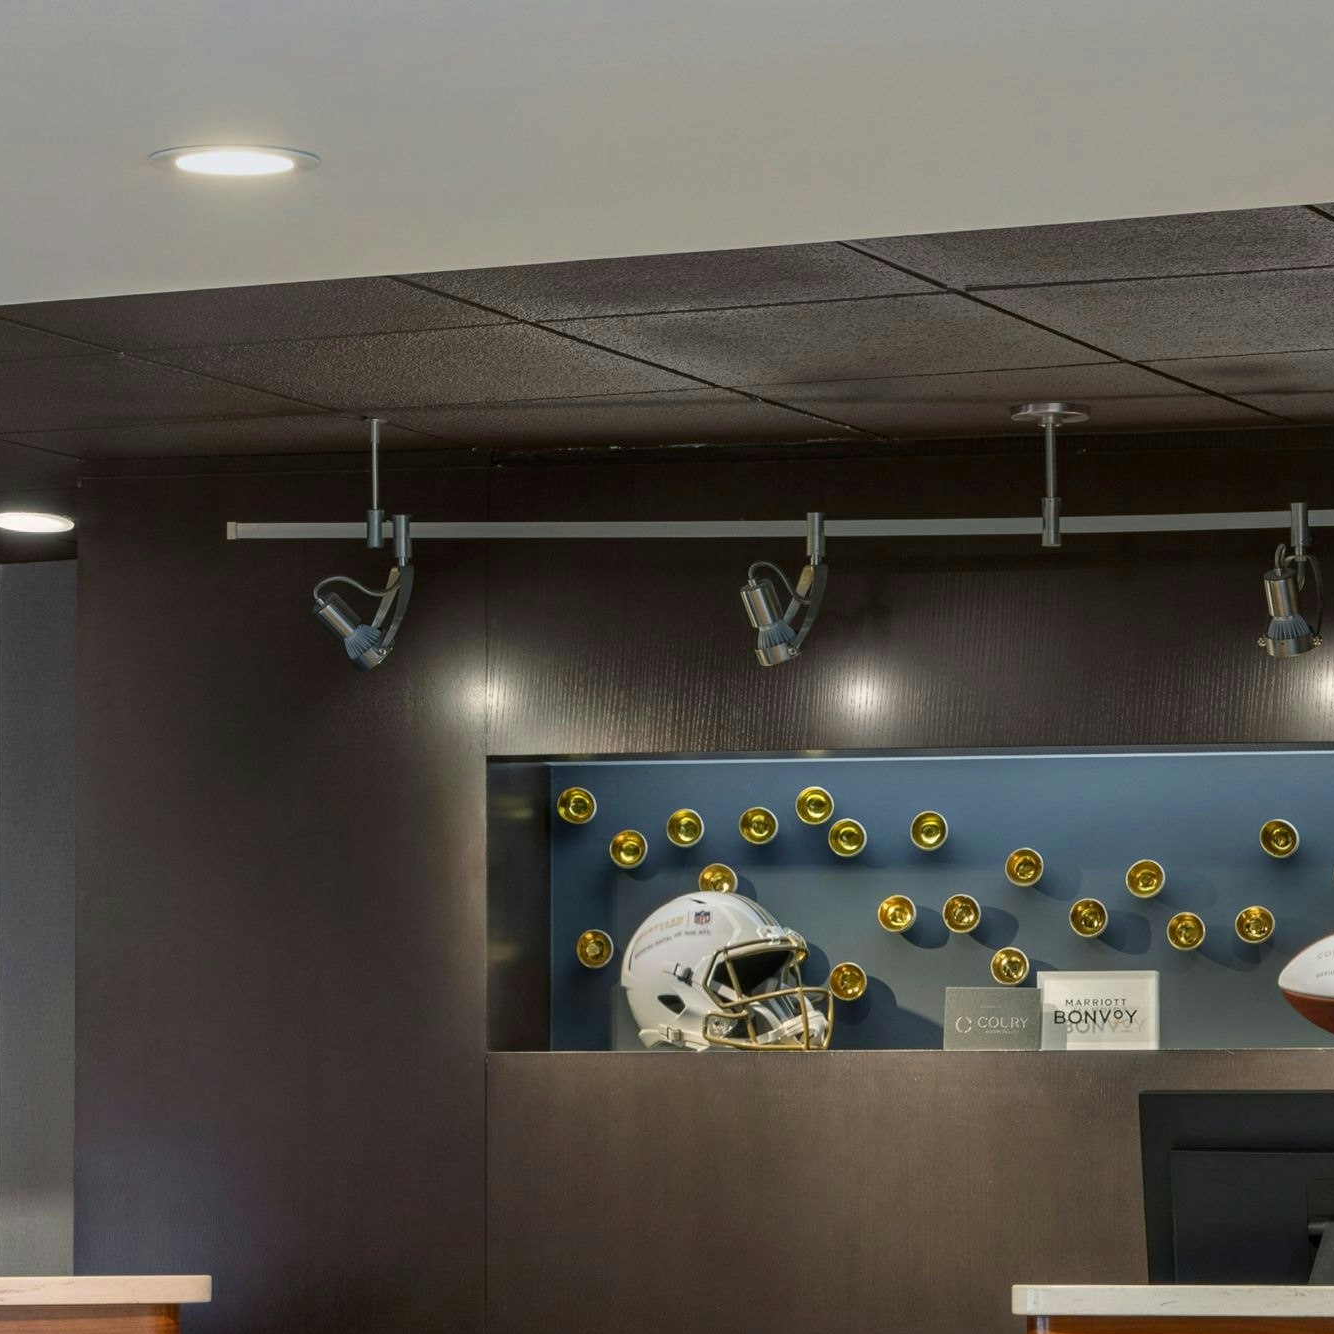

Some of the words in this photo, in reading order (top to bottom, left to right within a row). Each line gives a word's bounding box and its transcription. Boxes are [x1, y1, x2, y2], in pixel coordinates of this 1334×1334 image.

[1065, 998, 1127, 1007] MARRIOTT
[977, 1016, 1029, 1029] COURY
[1054, 1009, 1138, 1025] BONVOY
